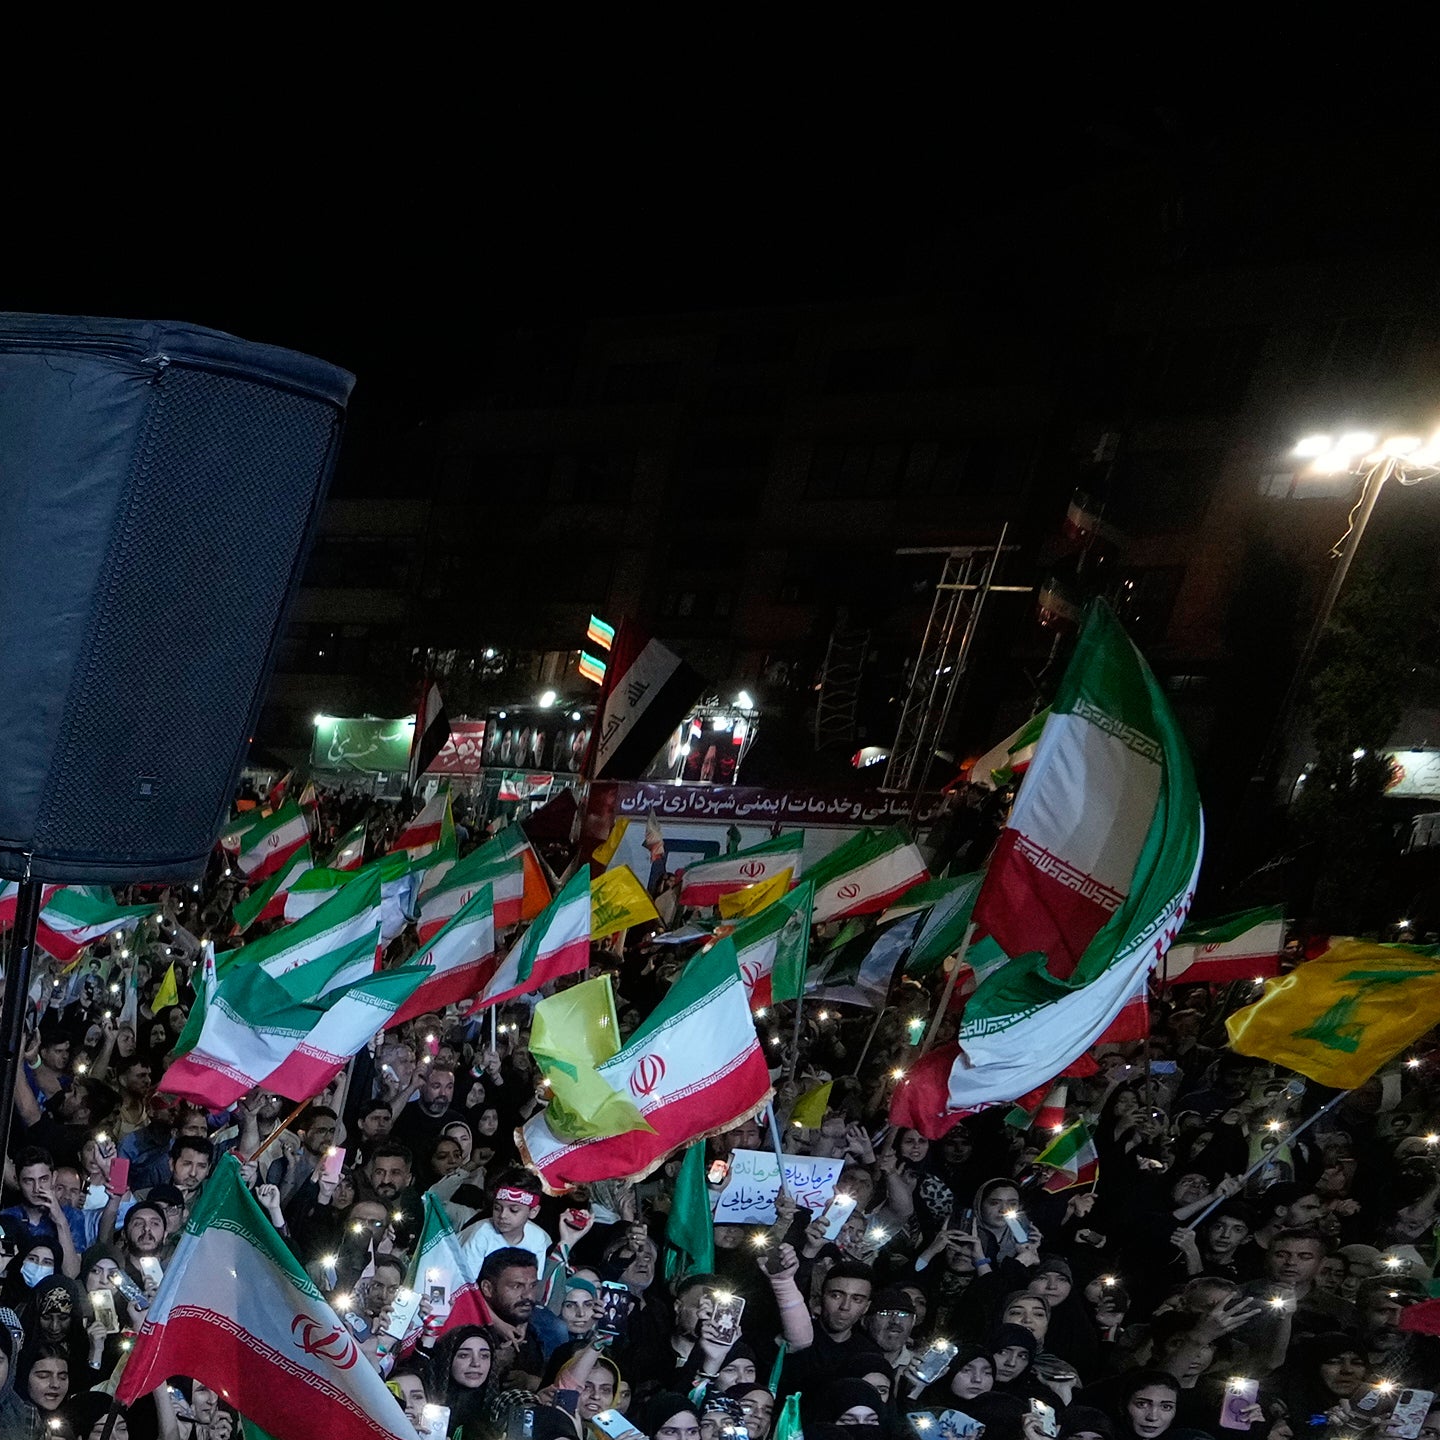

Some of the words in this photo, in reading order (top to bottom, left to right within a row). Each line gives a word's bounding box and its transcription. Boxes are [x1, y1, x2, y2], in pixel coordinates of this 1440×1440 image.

[620, 789, 664, 811] تهران
[662, 791, 736, 815] شهرداری
[735, 795, 788, 817] ایمنی
[787, 798, 852, 814] خدمات
